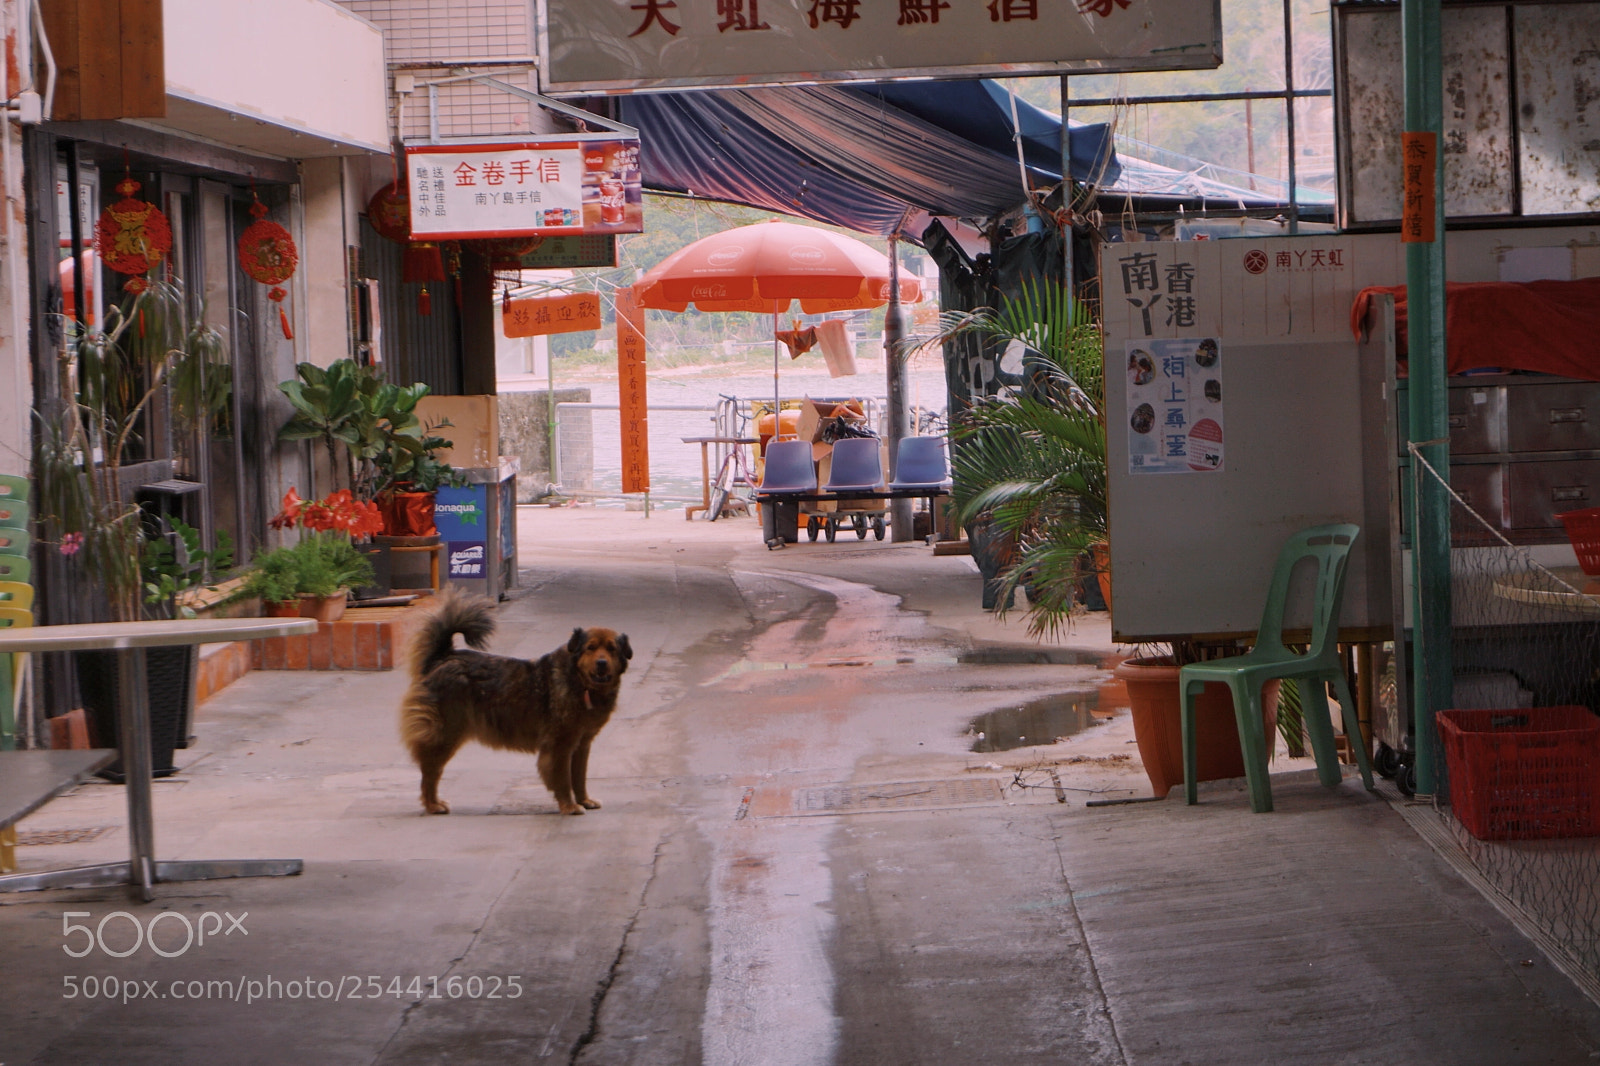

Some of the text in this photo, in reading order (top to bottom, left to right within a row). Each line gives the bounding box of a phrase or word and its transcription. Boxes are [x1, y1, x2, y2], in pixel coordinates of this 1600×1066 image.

[453, 158, 561, 186] 金卷手信
[474, 190, 542, 206] 南丫島手信
[1275, 249, 1344, 268] 南丫天虹
